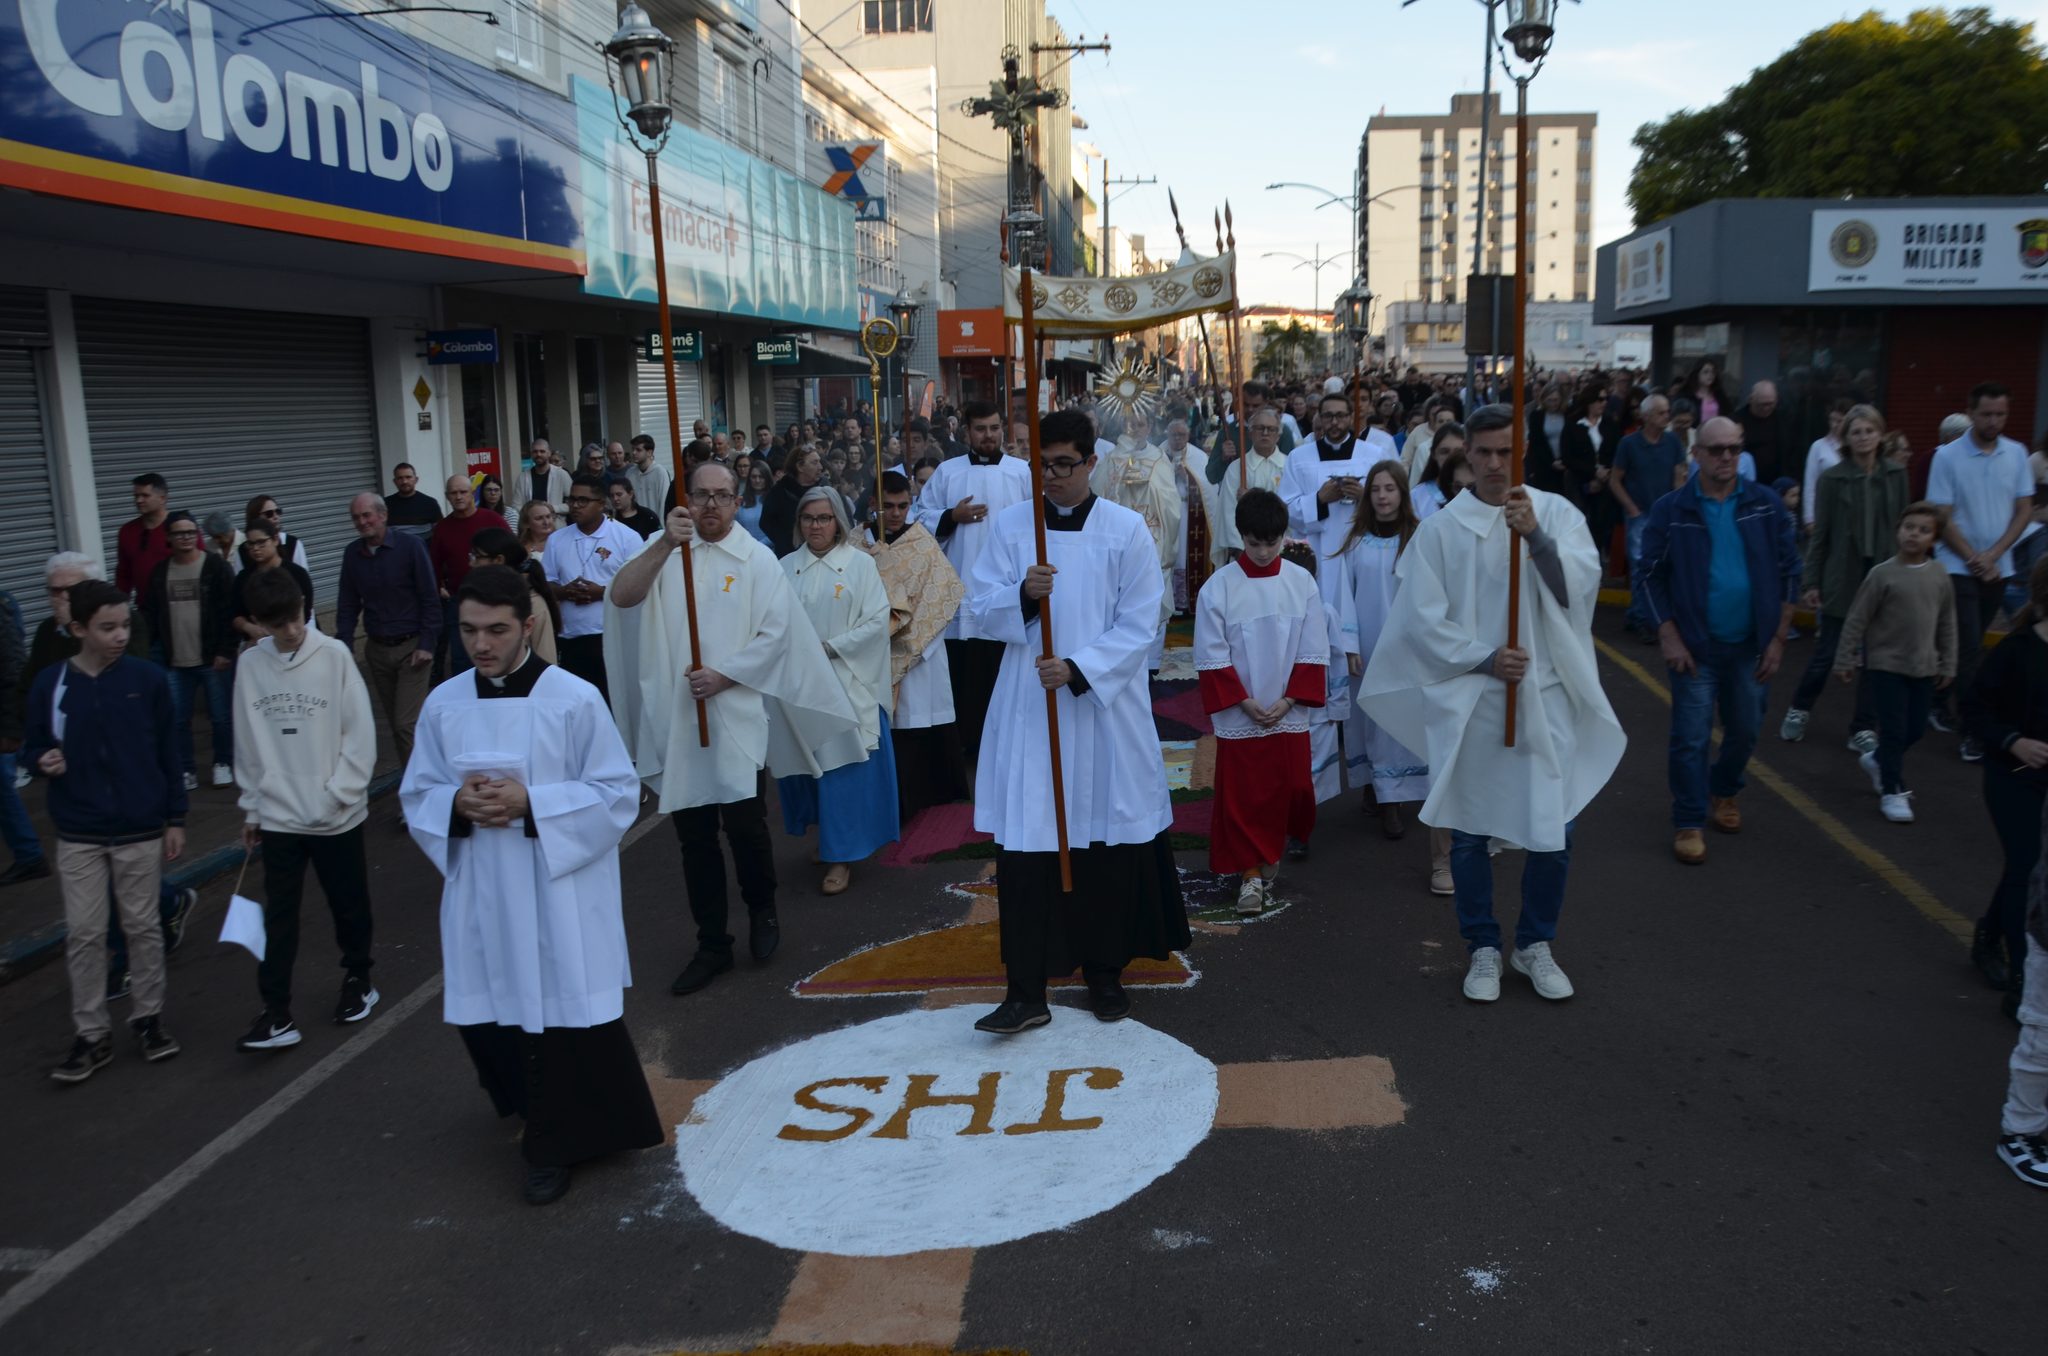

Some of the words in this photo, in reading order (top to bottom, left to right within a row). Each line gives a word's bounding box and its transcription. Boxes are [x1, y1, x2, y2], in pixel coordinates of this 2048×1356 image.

[1903, 223, 1986, 246] BRIGADA
[1903, 247, 1983, 270] MILITAR
[443, 341, 493, 353] Colombo
[296, 693, 328, 709] CLUB
